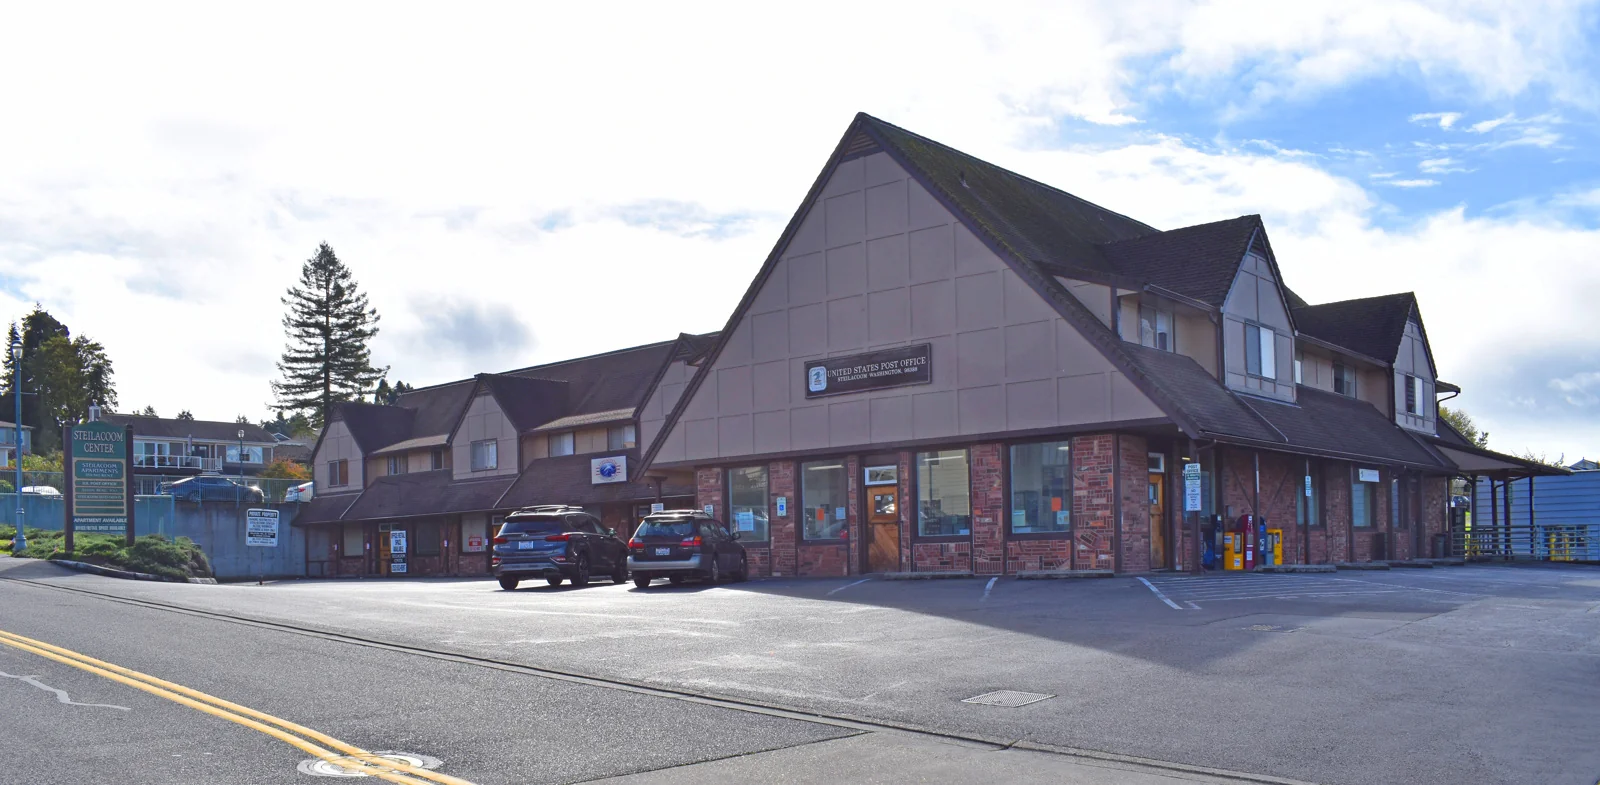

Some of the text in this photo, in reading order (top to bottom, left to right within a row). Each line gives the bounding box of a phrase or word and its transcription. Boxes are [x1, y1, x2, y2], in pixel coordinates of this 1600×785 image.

[827, 356, 926, 377] UNITED STATES POST OFFICE
[837, 373, 868, 382] STEILACOOM
[73, 430, 124, 442] STEILACOOM
[83, 442, 115, 453] CENTER
